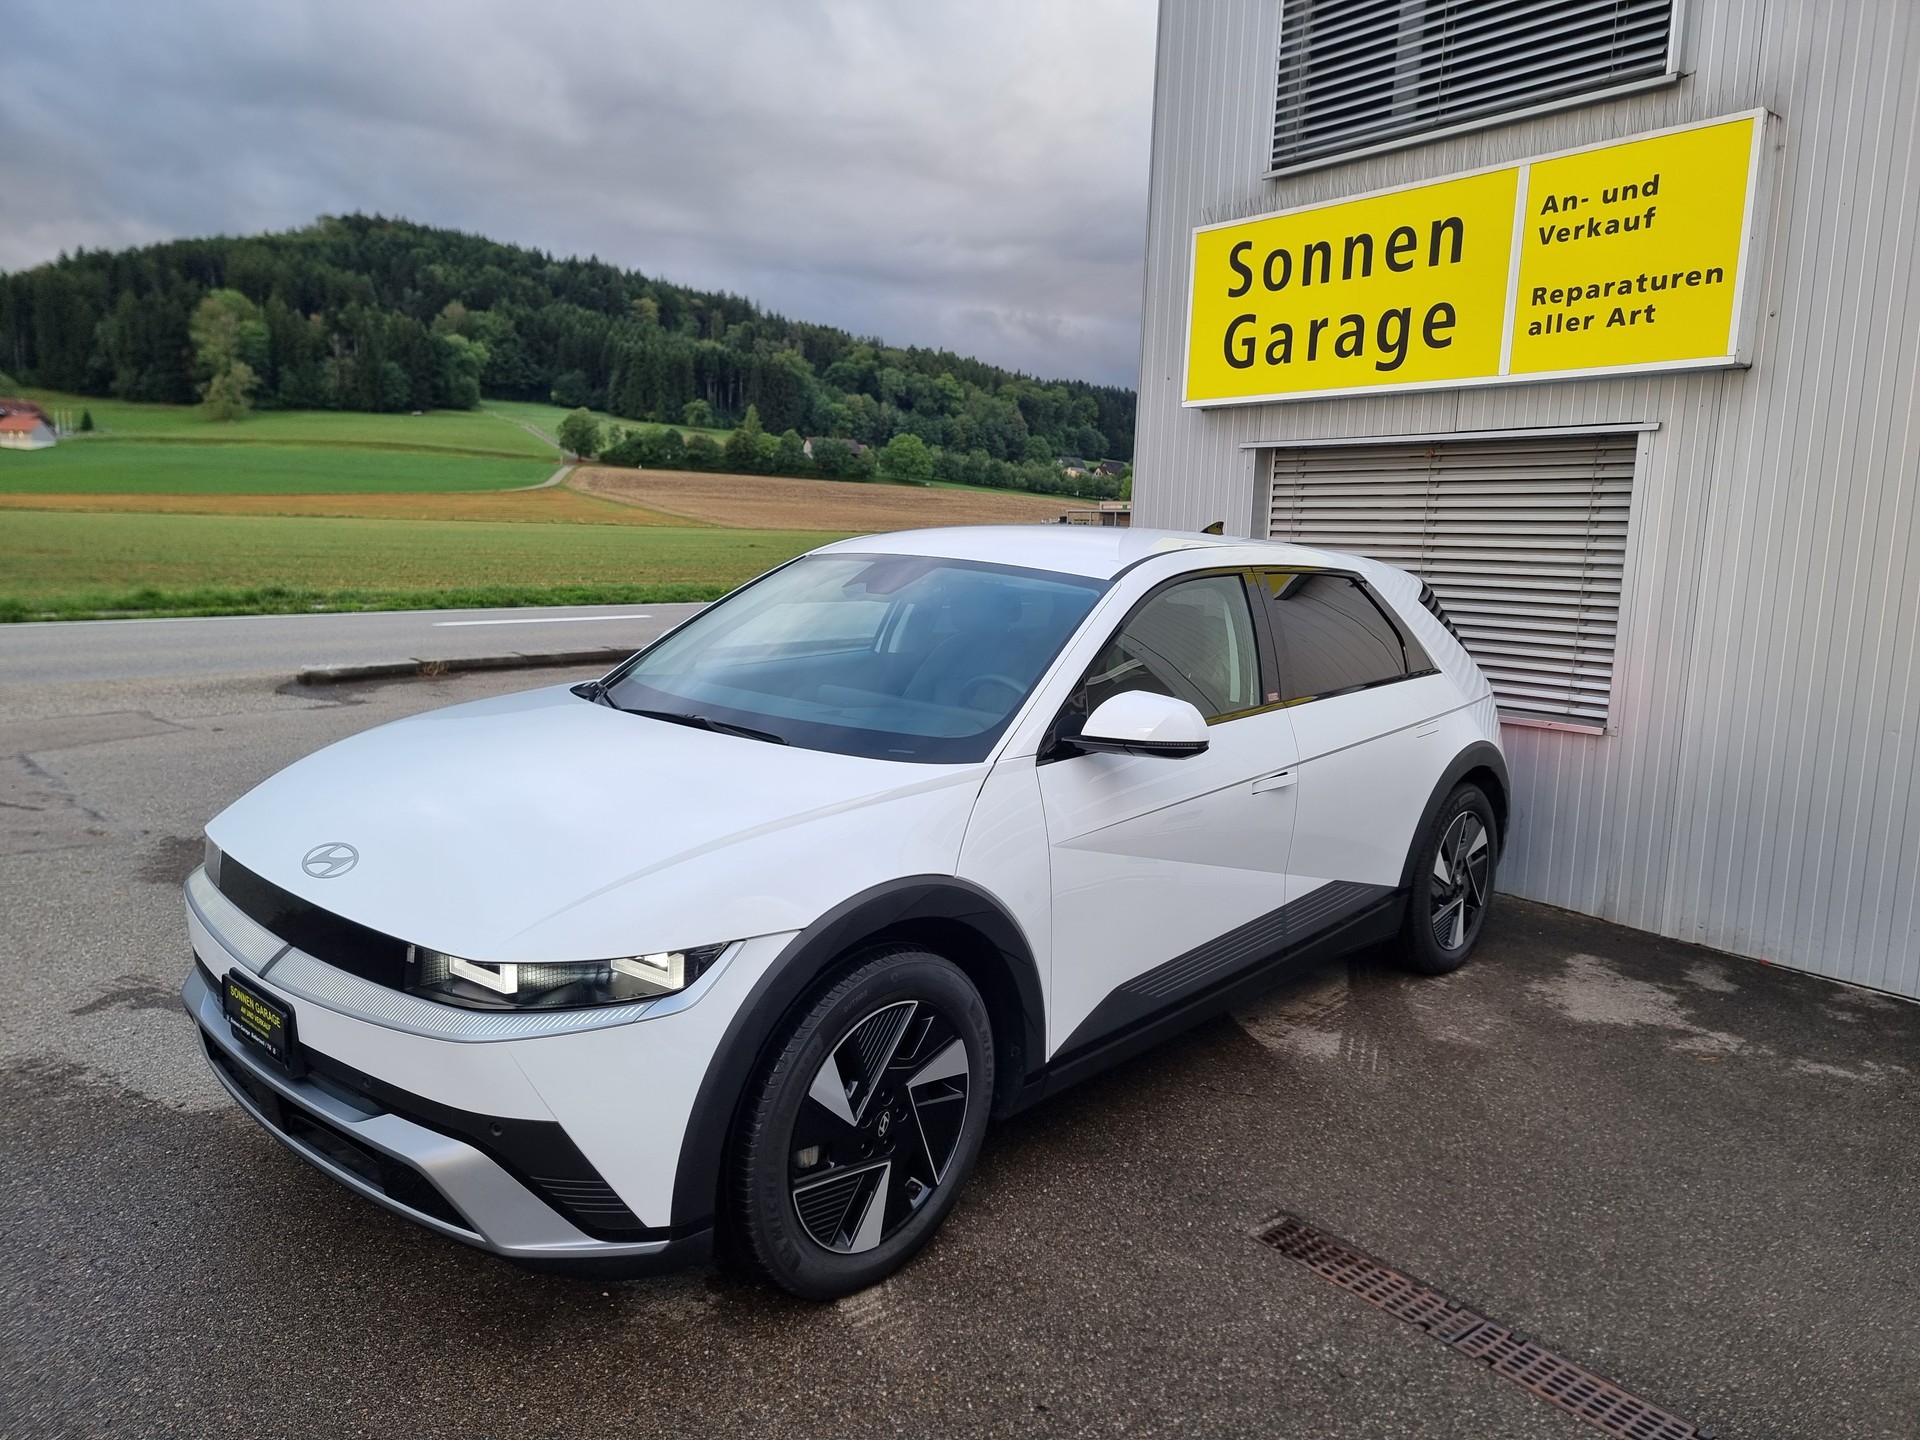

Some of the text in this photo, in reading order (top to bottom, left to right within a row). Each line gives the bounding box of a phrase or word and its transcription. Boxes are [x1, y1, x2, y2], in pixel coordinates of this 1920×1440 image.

[1540, 173, 1660, 216] An- und
[1538, 206, 1658, 246] Verkauf
[1227, 216, 1464, 298] Sonnen
[1530, 266, 1724, 309] Reparaturen
[1223, 302, 1456, 372] Garage
[1528, 304, 1656, 336] aller Art
[230, 985, 254, 1010] SONNEN
[255, 1003, 281, 1028] GARAGE
